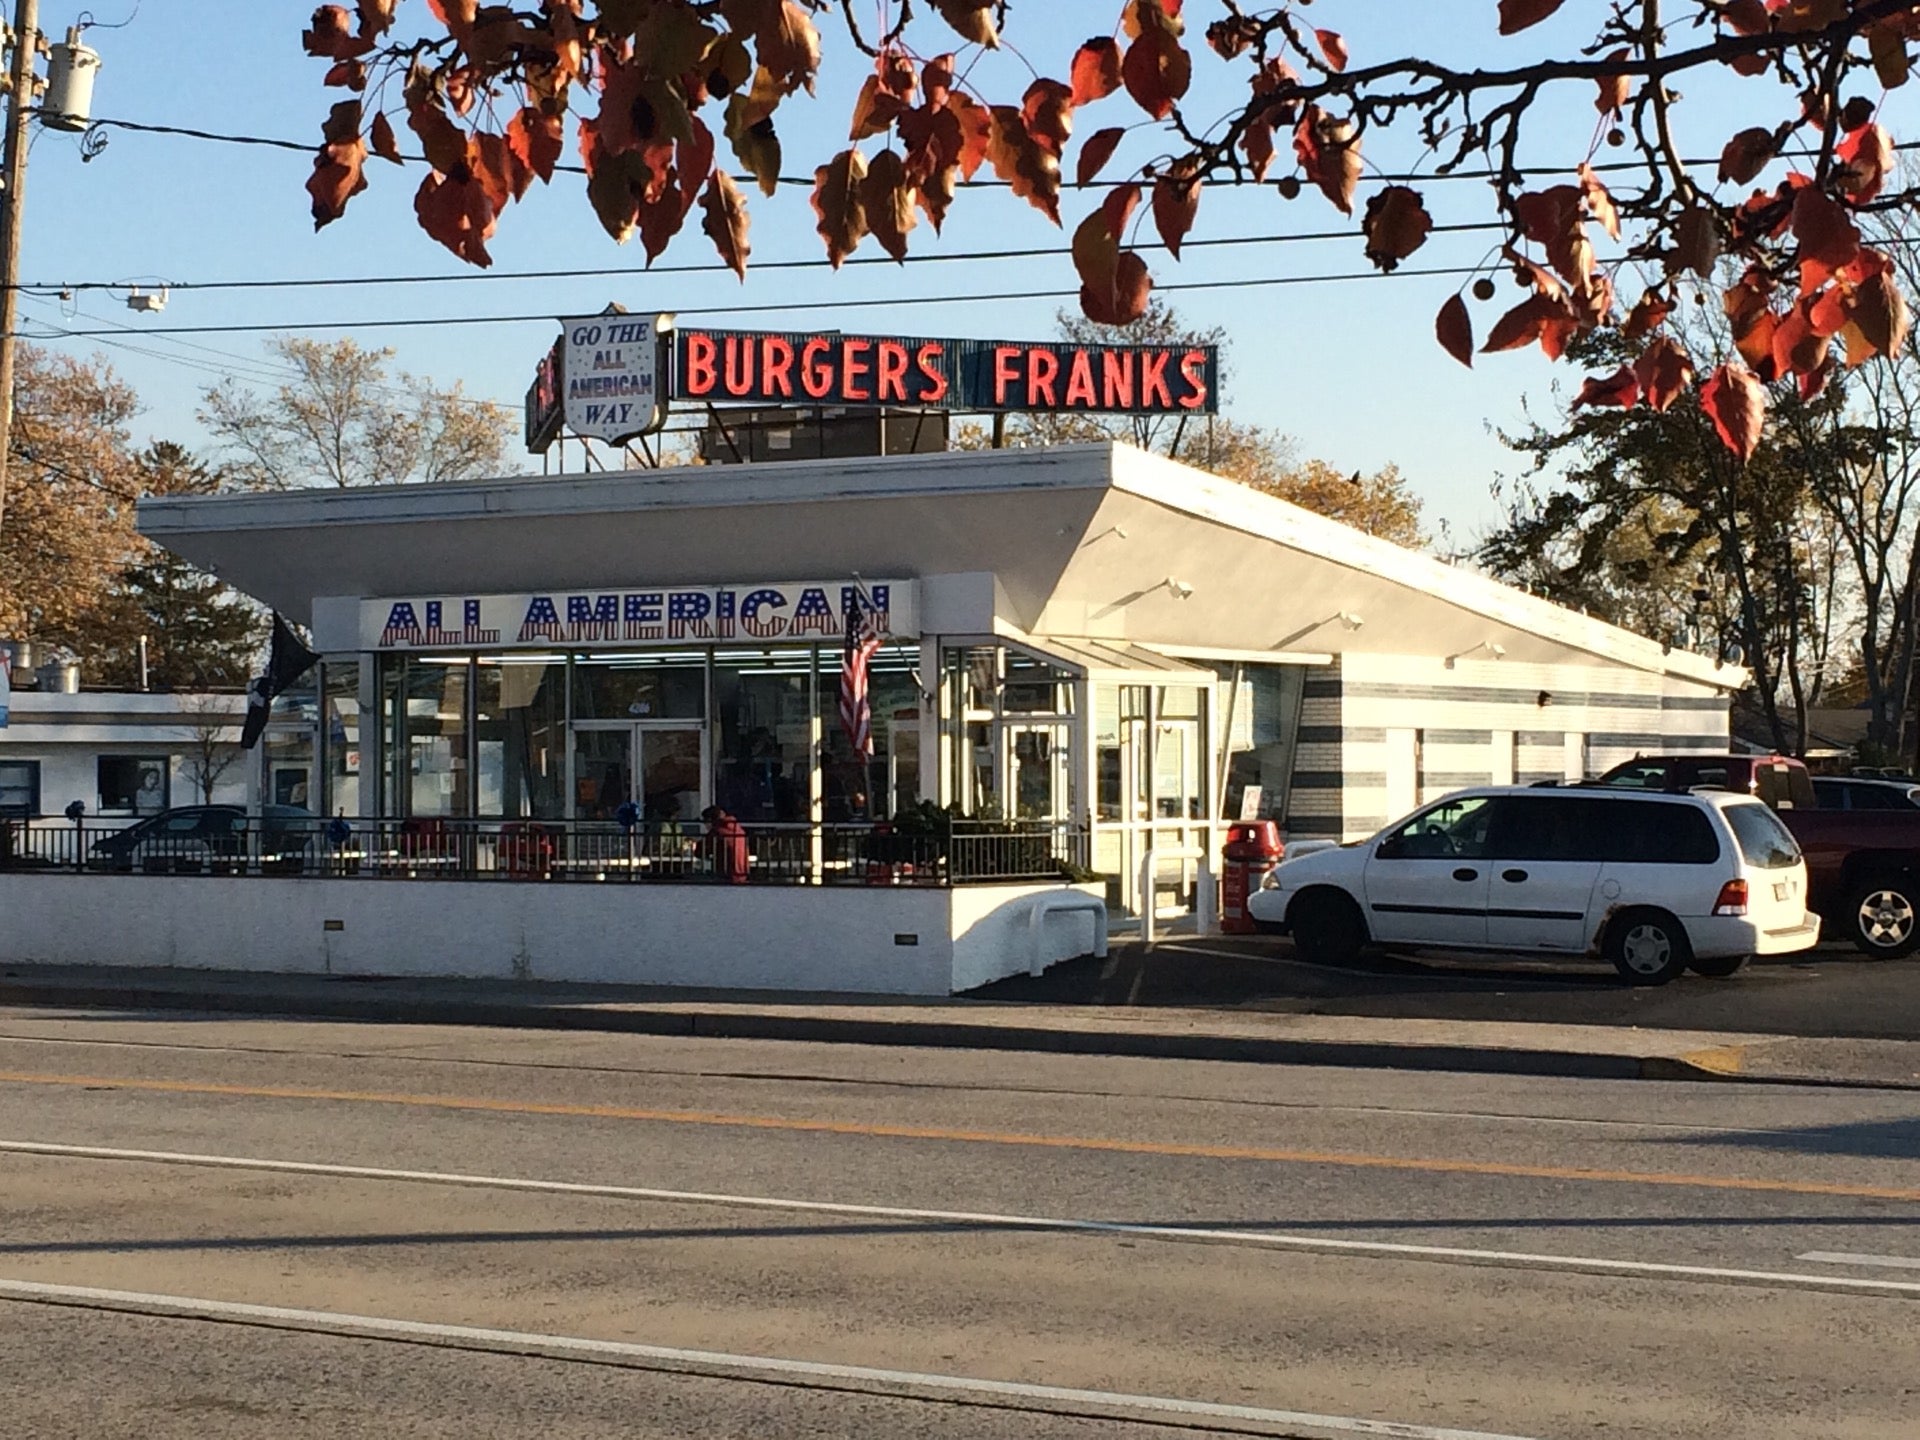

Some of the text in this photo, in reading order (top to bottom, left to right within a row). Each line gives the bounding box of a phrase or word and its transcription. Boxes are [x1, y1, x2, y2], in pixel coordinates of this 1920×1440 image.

[572, 323, 649, 346] GO THE
[592, 350, 626, 371] ALL
[687, 335, 1207, 408] BURGERS FRANKS
[569, 374, 652, 399] AMERICAN
[585, 403, 634, 425] WAY
[379, 585, 889, 647] ALL AMERICAN
